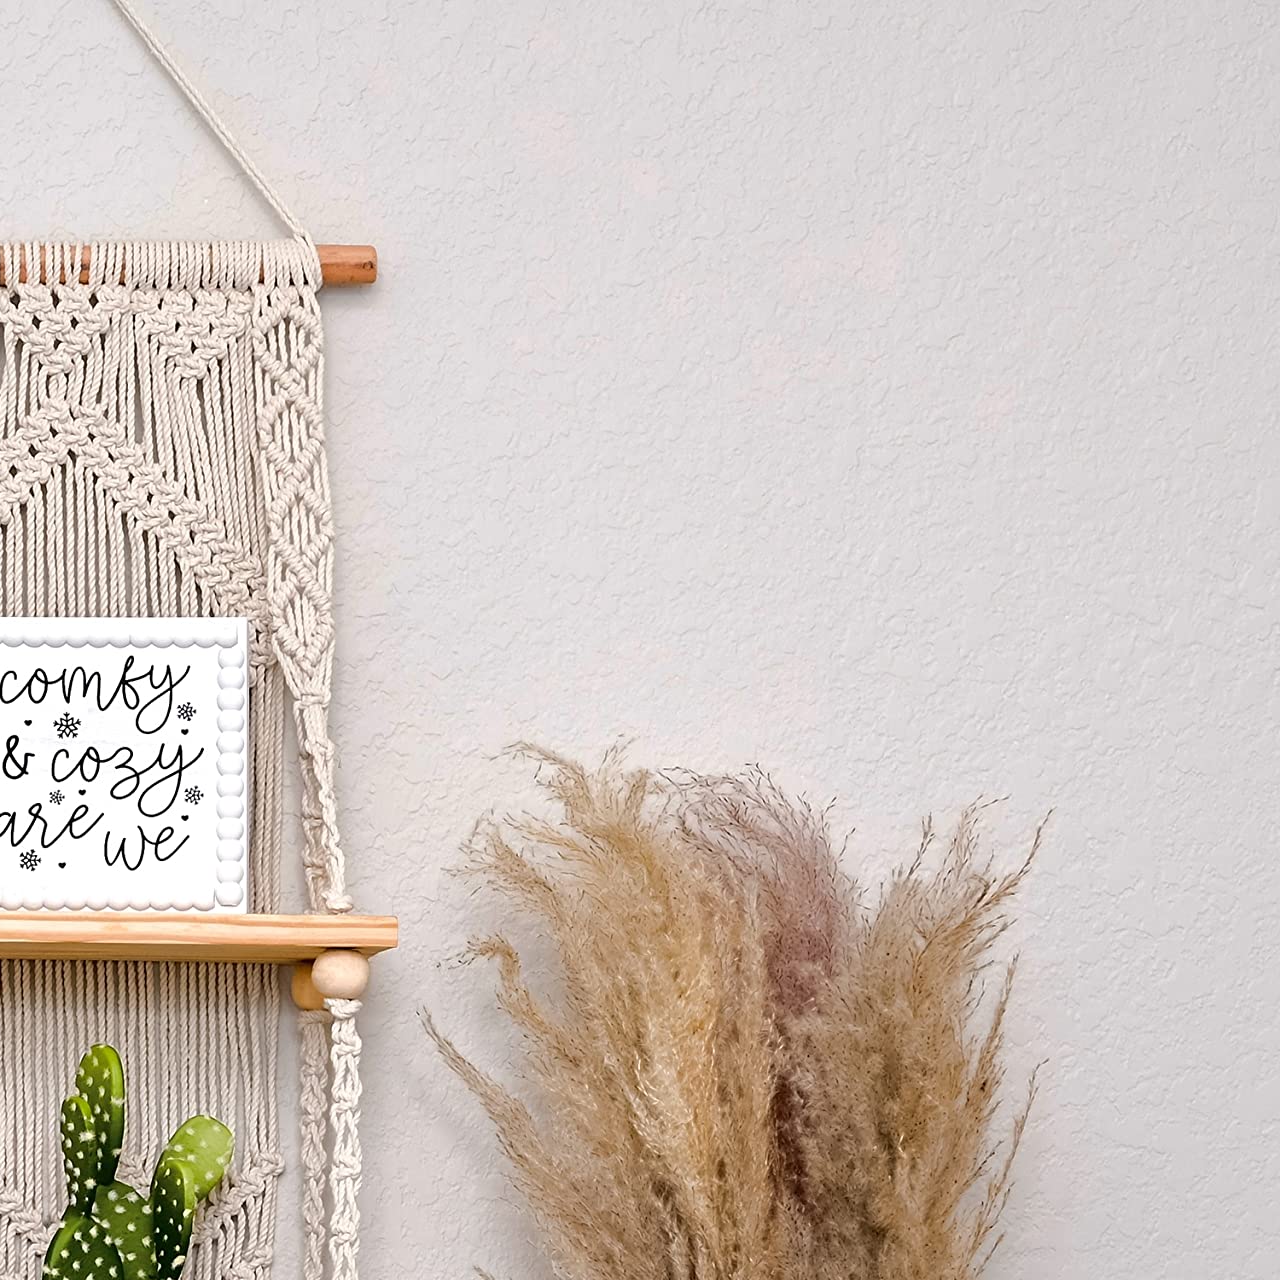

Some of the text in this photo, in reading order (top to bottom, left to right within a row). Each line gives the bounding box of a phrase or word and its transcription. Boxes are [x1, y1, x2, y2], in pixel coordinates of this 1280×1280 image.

[0, 655, 190, 734] comfy
[2, 735, 204, 817] & cozy
[104, 825, 190, 870] we
